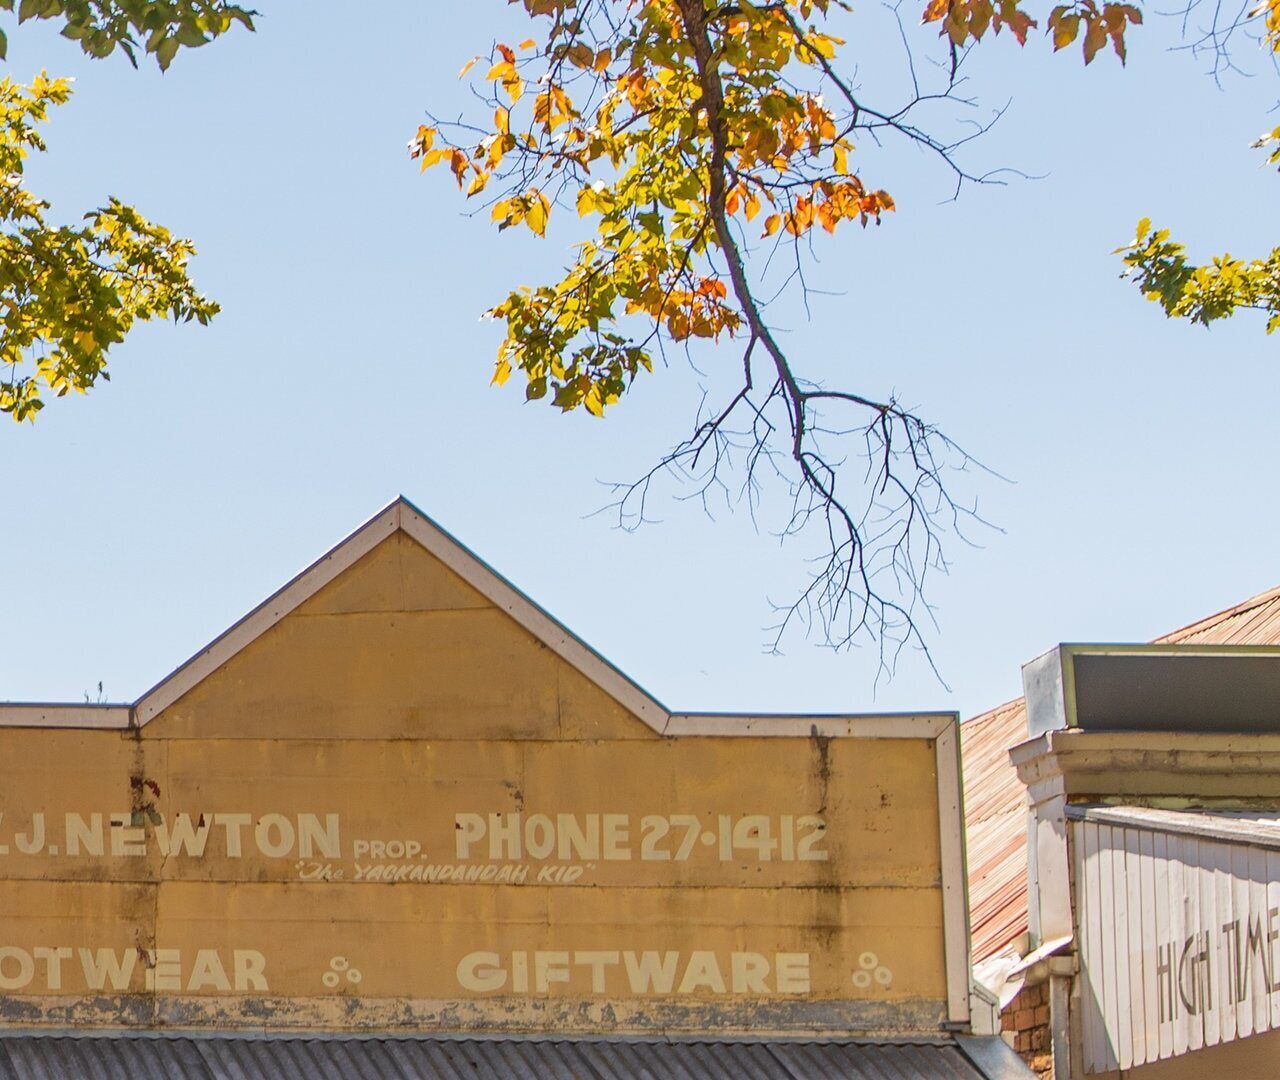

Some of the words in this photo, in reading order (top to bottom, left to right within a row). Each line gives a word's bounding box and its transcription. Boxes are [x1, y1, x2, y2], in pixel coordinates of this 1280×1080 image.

[354, 840, 428, 860] PROP.
[455, 812, 631, 862] PHONE
[353, 861, 530, 883] YACKANDANDAH
[455, 951, 811, 994] GIFTWARE
